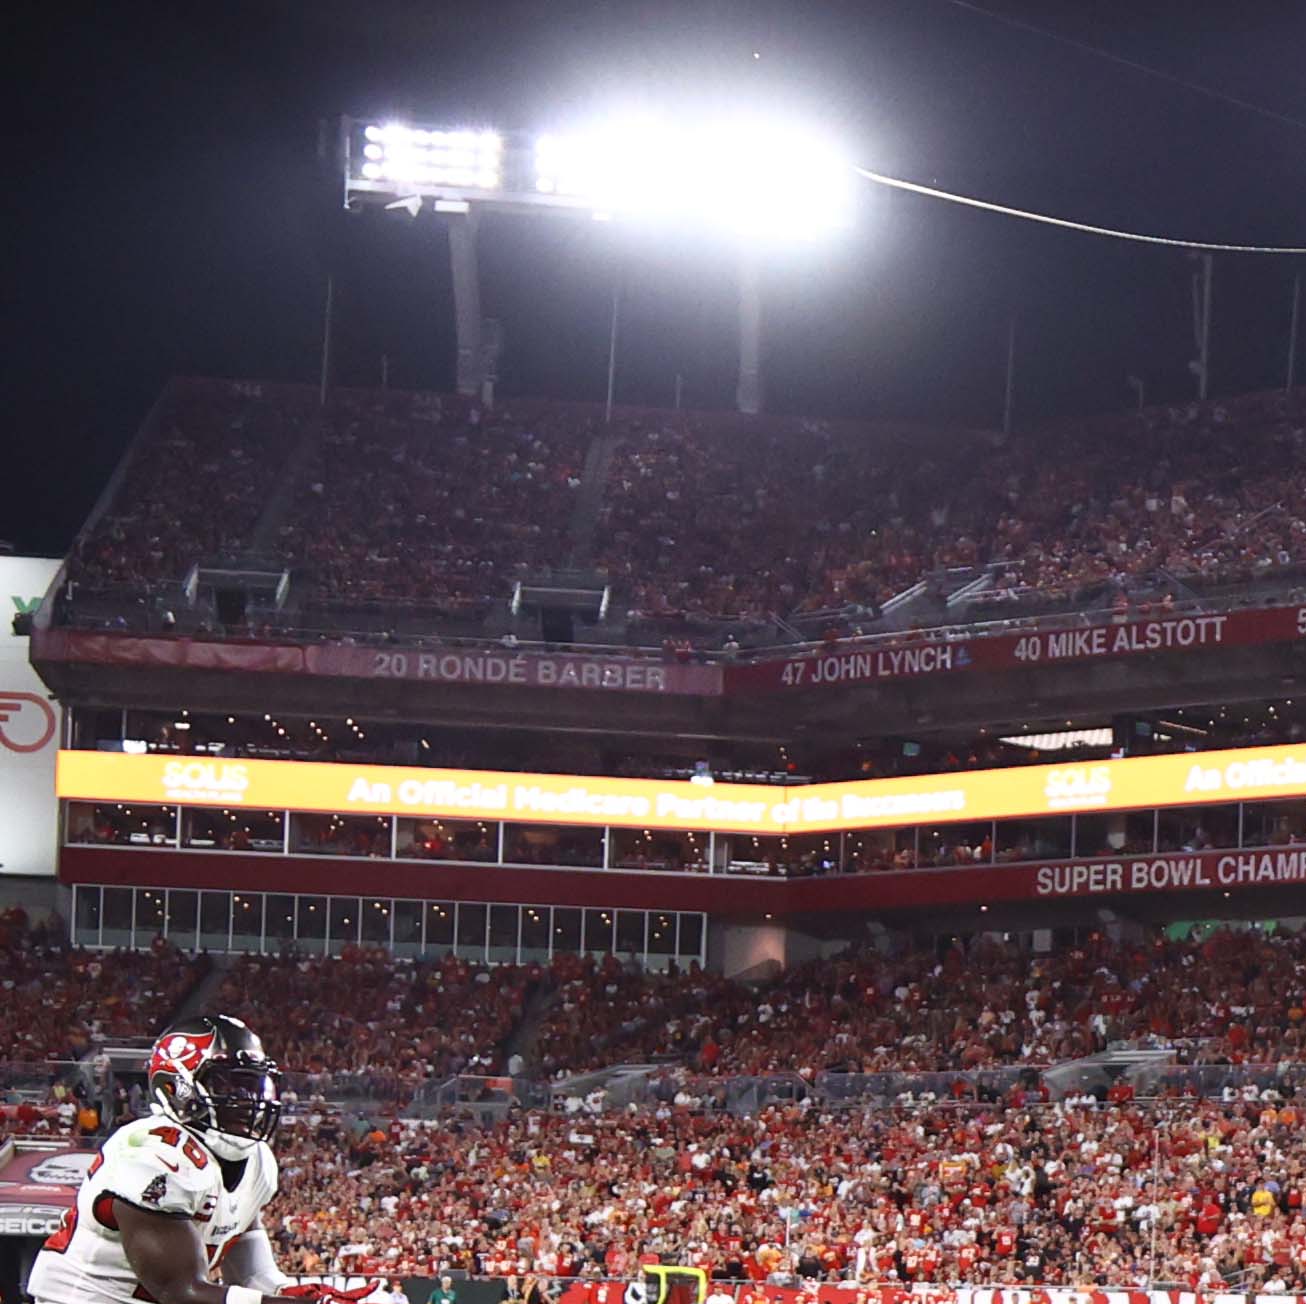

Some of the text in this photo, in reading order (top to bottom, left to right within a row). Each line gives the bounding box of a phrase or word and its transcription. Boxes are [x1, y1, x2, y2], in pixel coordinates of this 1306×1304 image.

[1014, 616, 1227, 661] 40 MIKE ALSTOTT
[373, 651, 666, 690] 20 RONDÉ BARBER
[781, 646, 952, 685] 47 JOHN LYNCH
[1036, 864, 1122, 895] SUPER
[1131, 859, 1210, 888] BOWL
[0, 1218, 61, 1234] EICO
